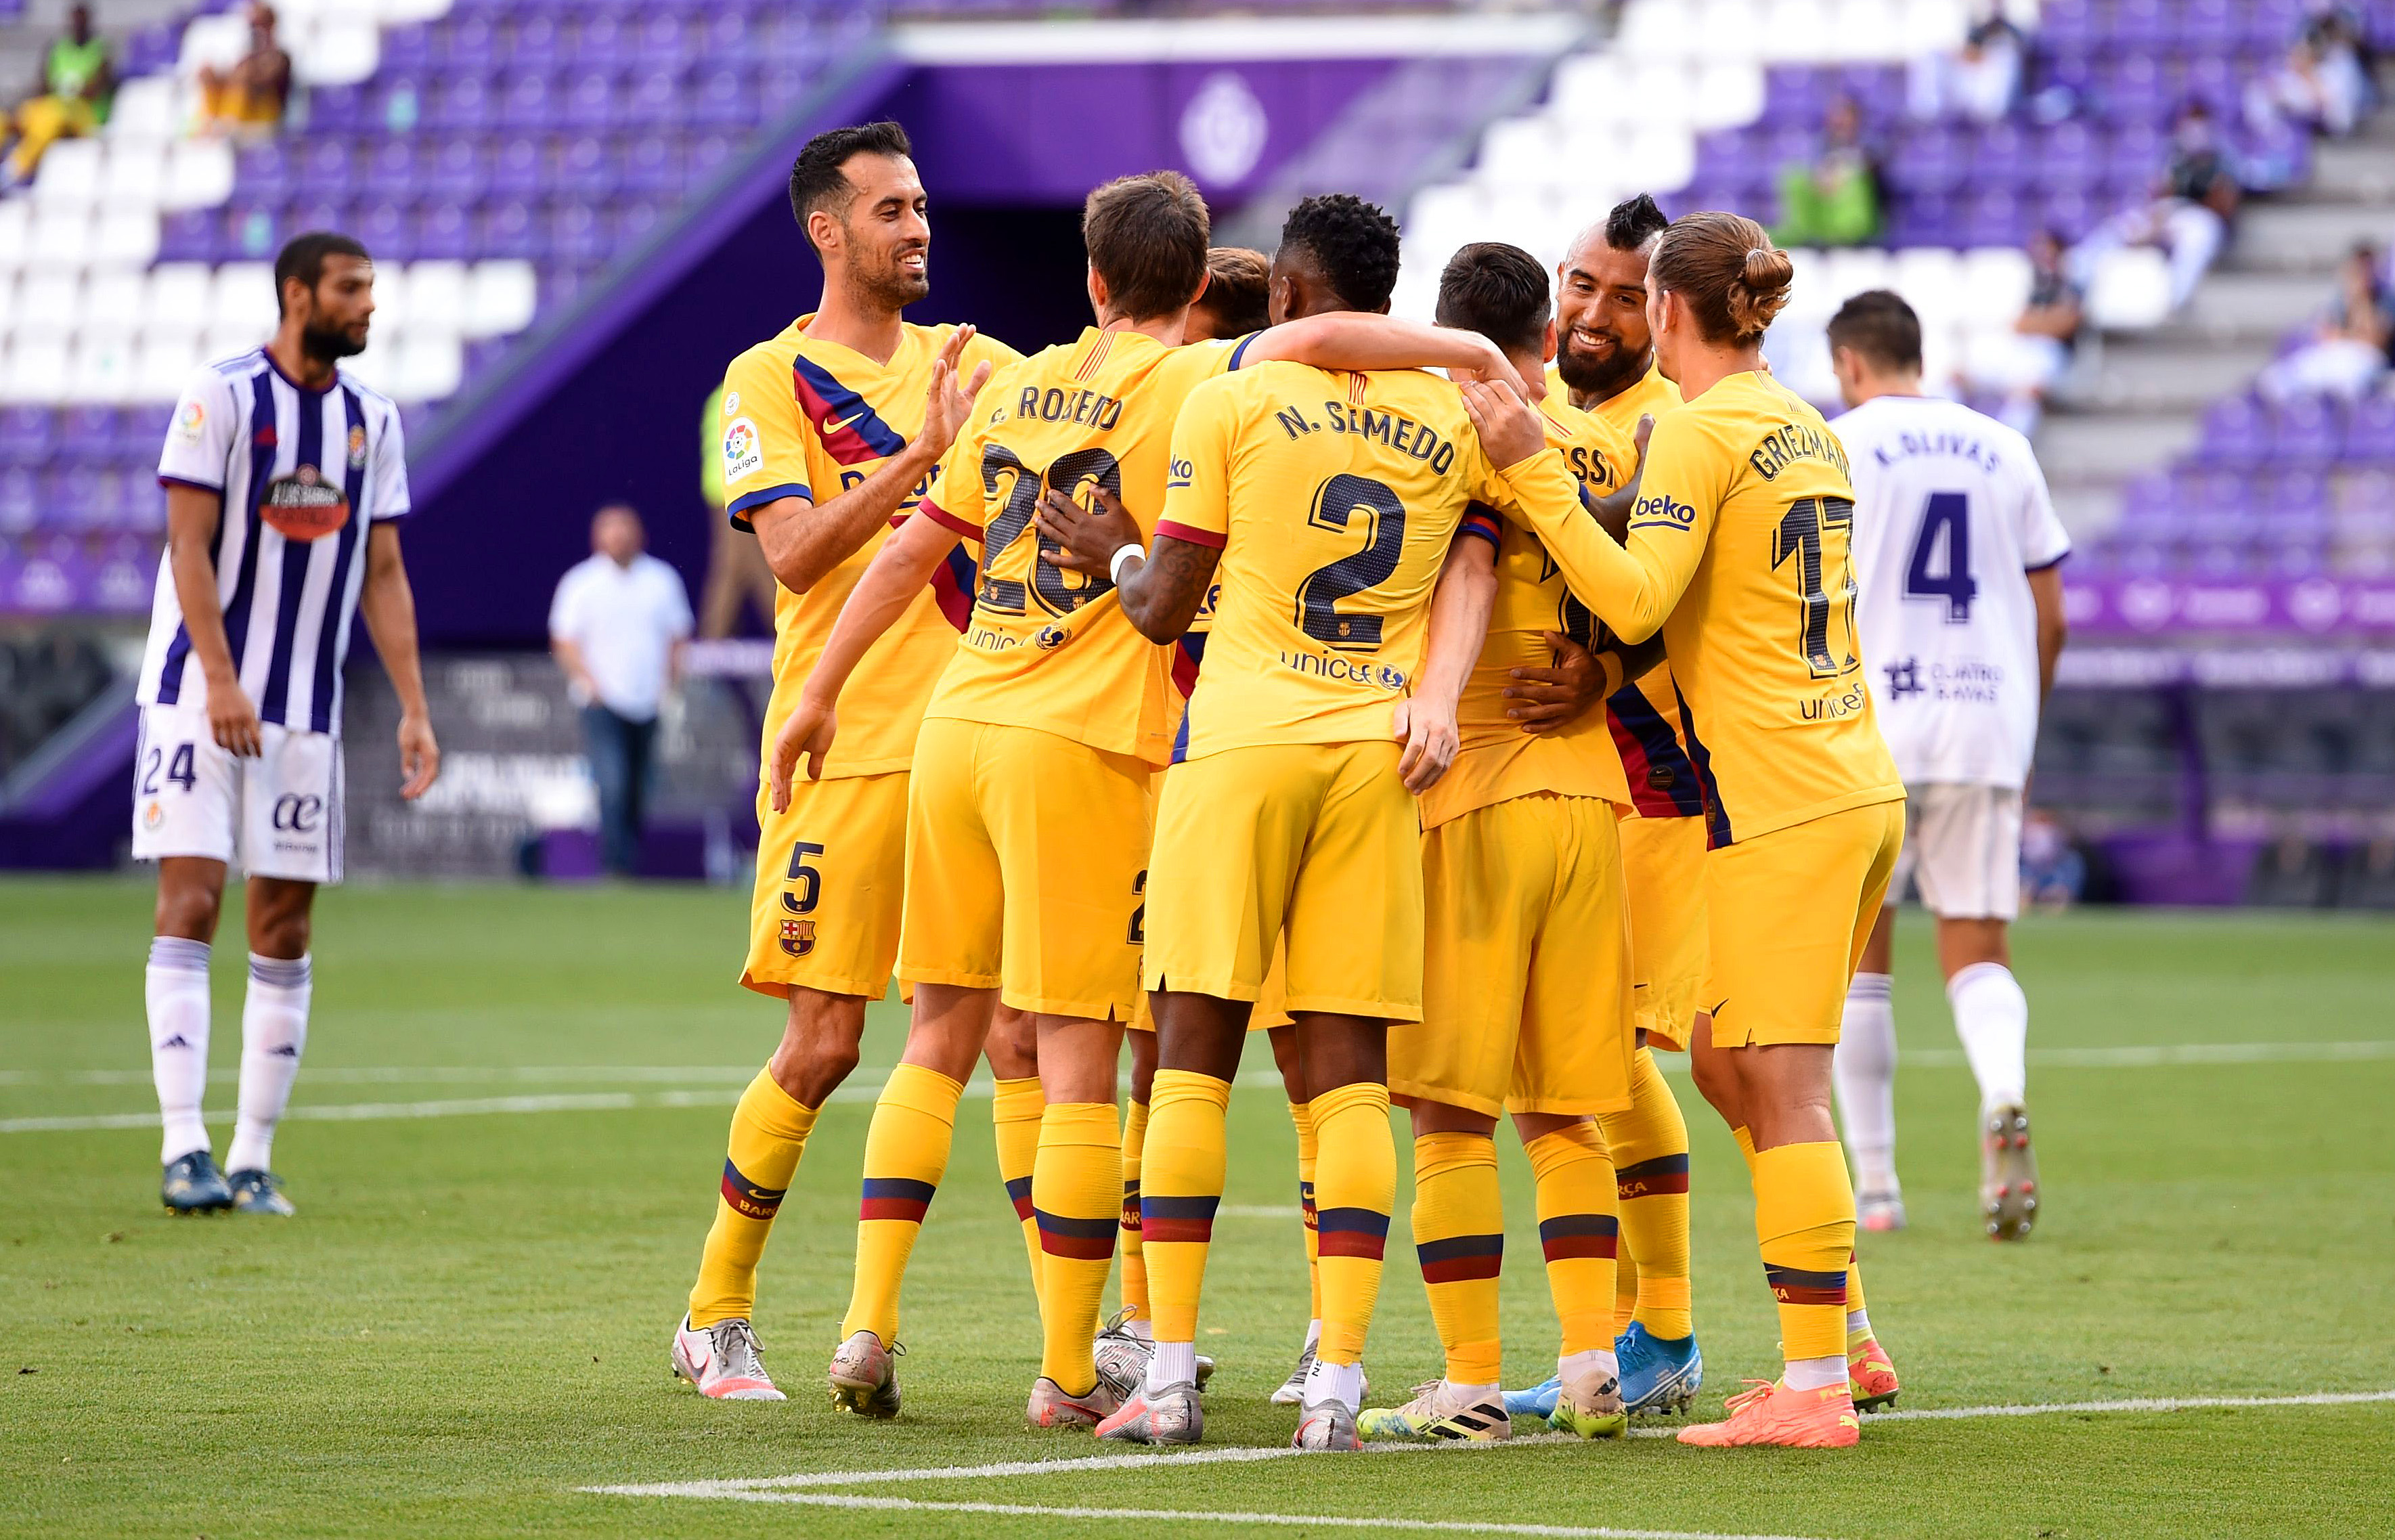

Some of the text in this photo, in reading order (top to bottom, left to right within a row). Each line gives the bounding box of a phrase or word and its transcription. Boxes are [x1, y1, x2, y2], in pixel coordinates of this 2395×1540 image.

[728, 456, 757, 476] LaLiga
[1275, 401, 1455, 475] N. SEMEDO
[1636, 495, 1696, 523] beko
[1294, 473, 1406, 653] 2
[1901, 491, 1979, 624] 4
[1800, 682, 1866, 720] unicef
[141, 743, 196, 795] 24
[781, 841, 825, 915] 5
